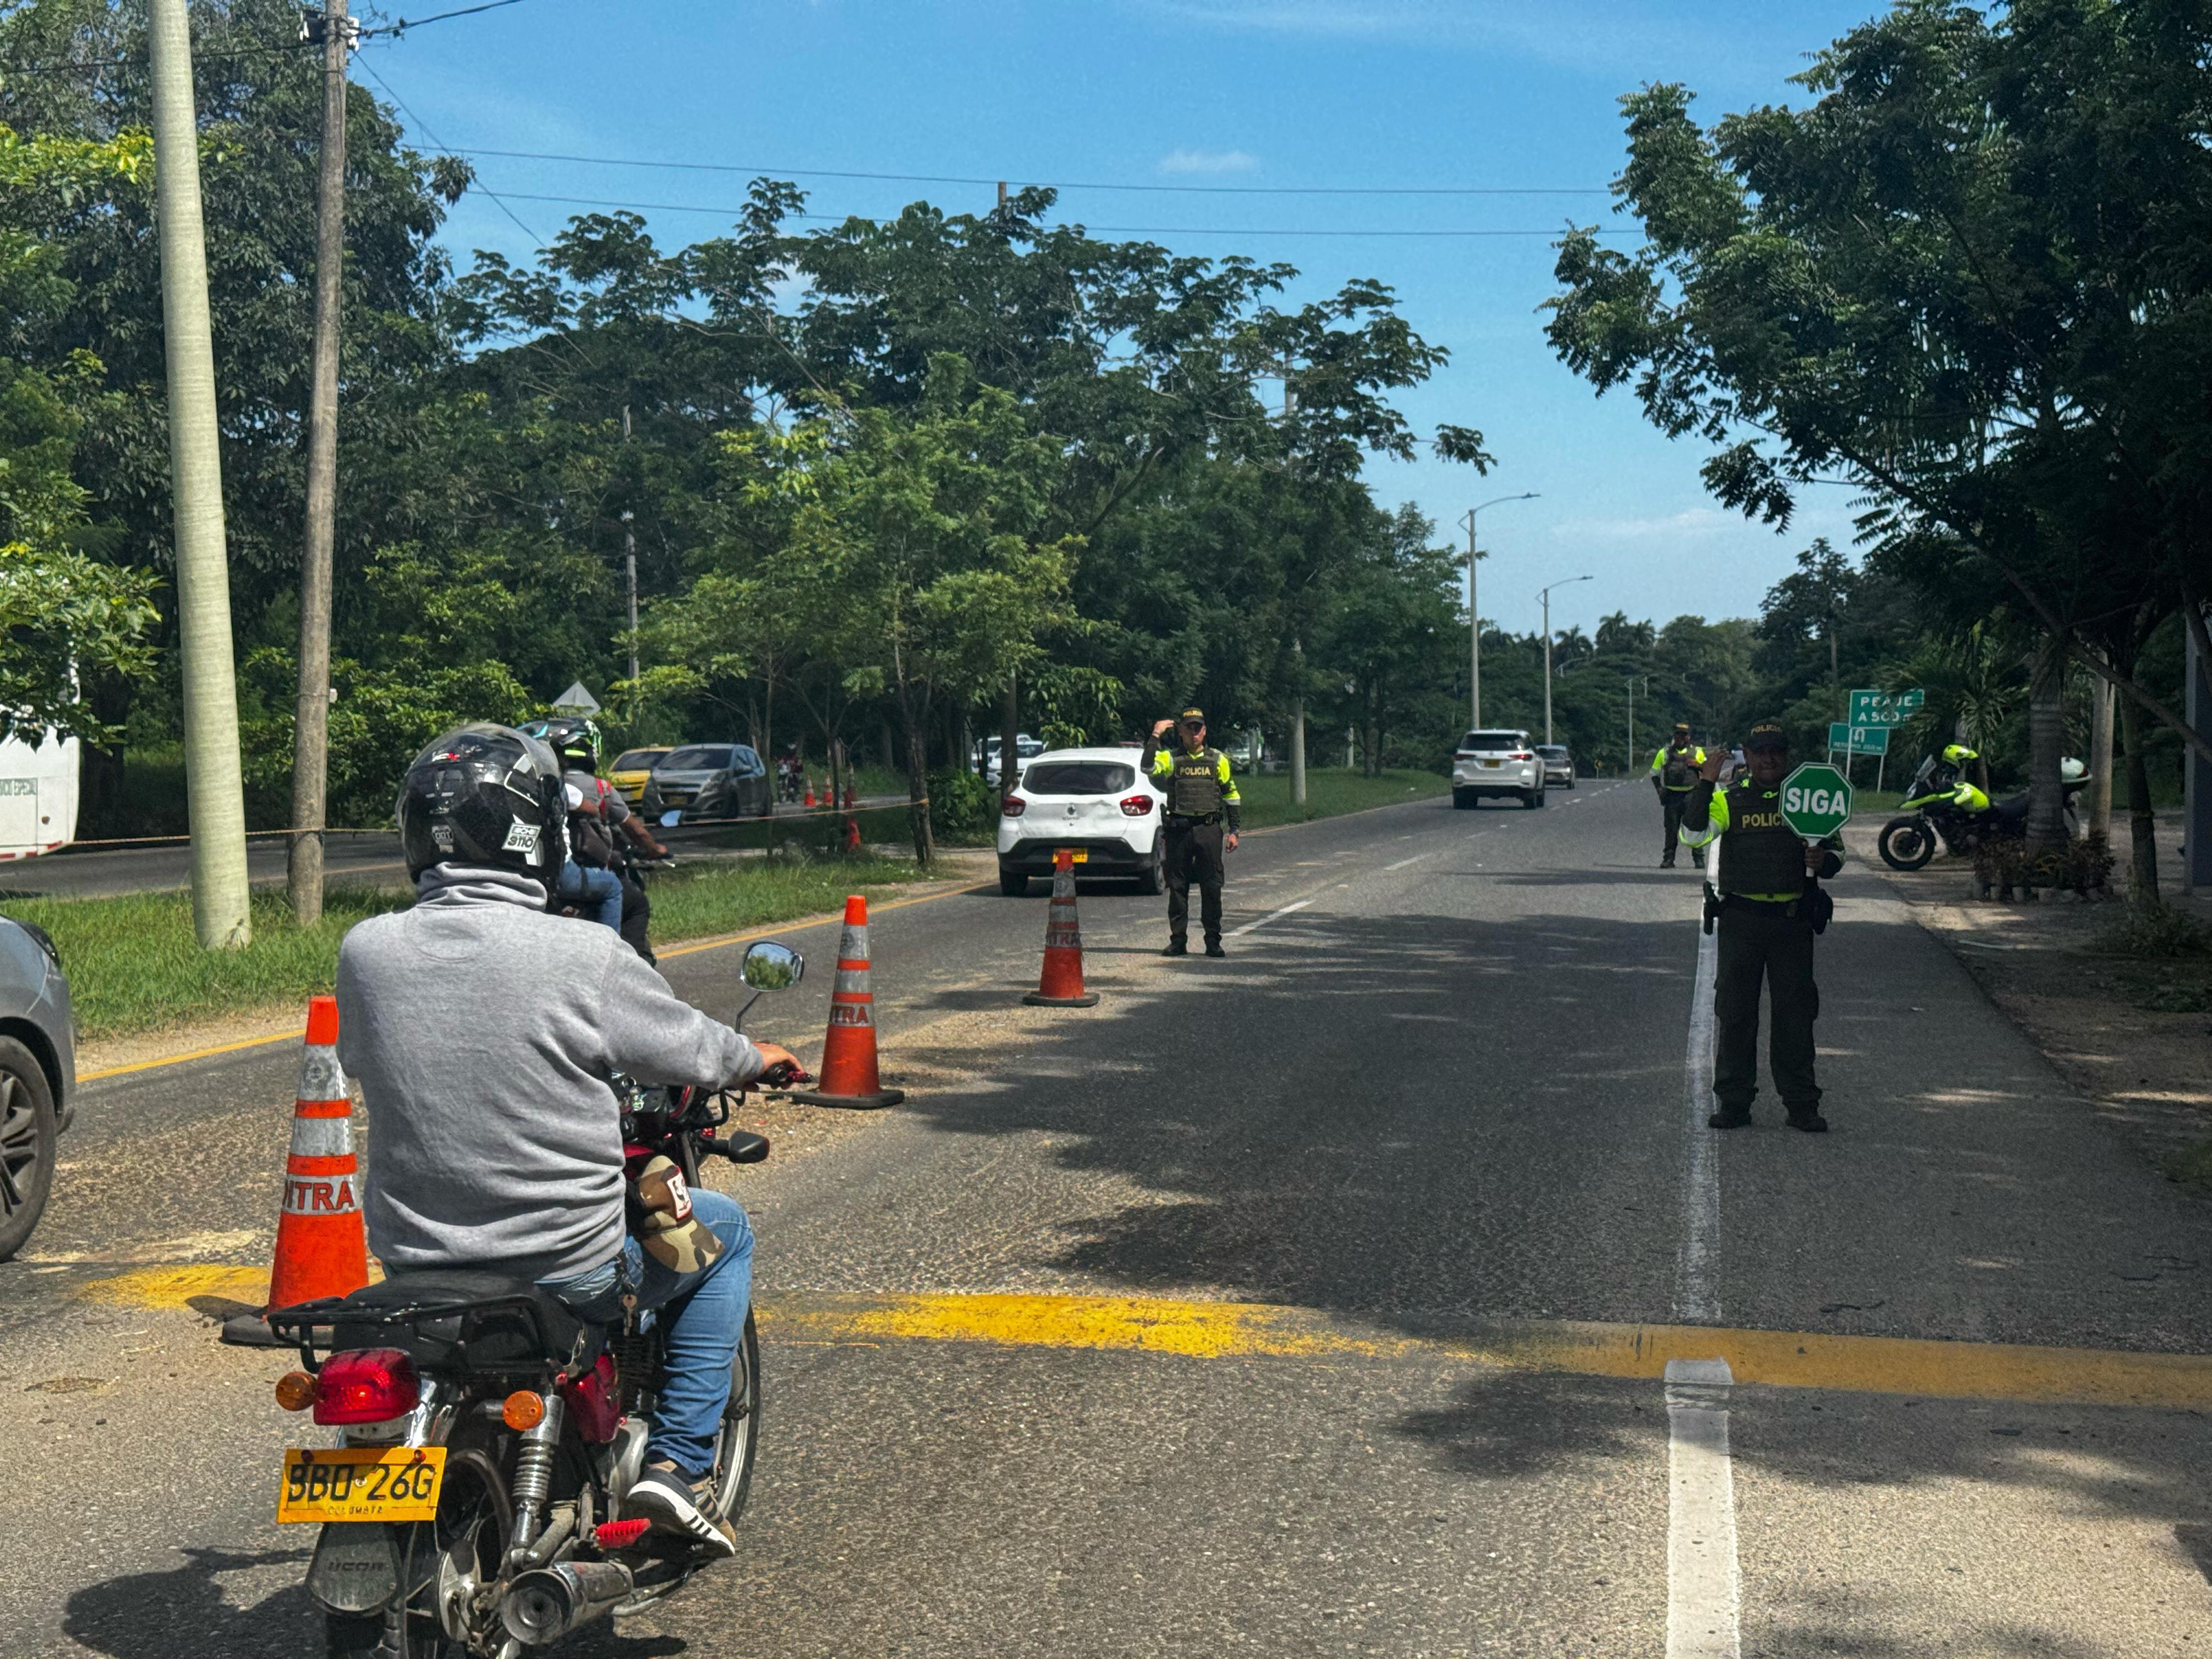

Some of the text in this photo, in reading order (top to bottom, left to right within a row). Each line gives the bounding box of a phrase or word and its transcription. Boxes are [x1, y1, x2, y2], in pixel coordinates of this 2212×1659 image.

[1180, 767, 1211, 775] POLICIA
[1785, 787, 1847, 816] SIGA
[1742, 812, 1784, 828] POLIC
[282, 1180, 355, 1210] ITRA
[366, 1464, 436, 1500] 26G
